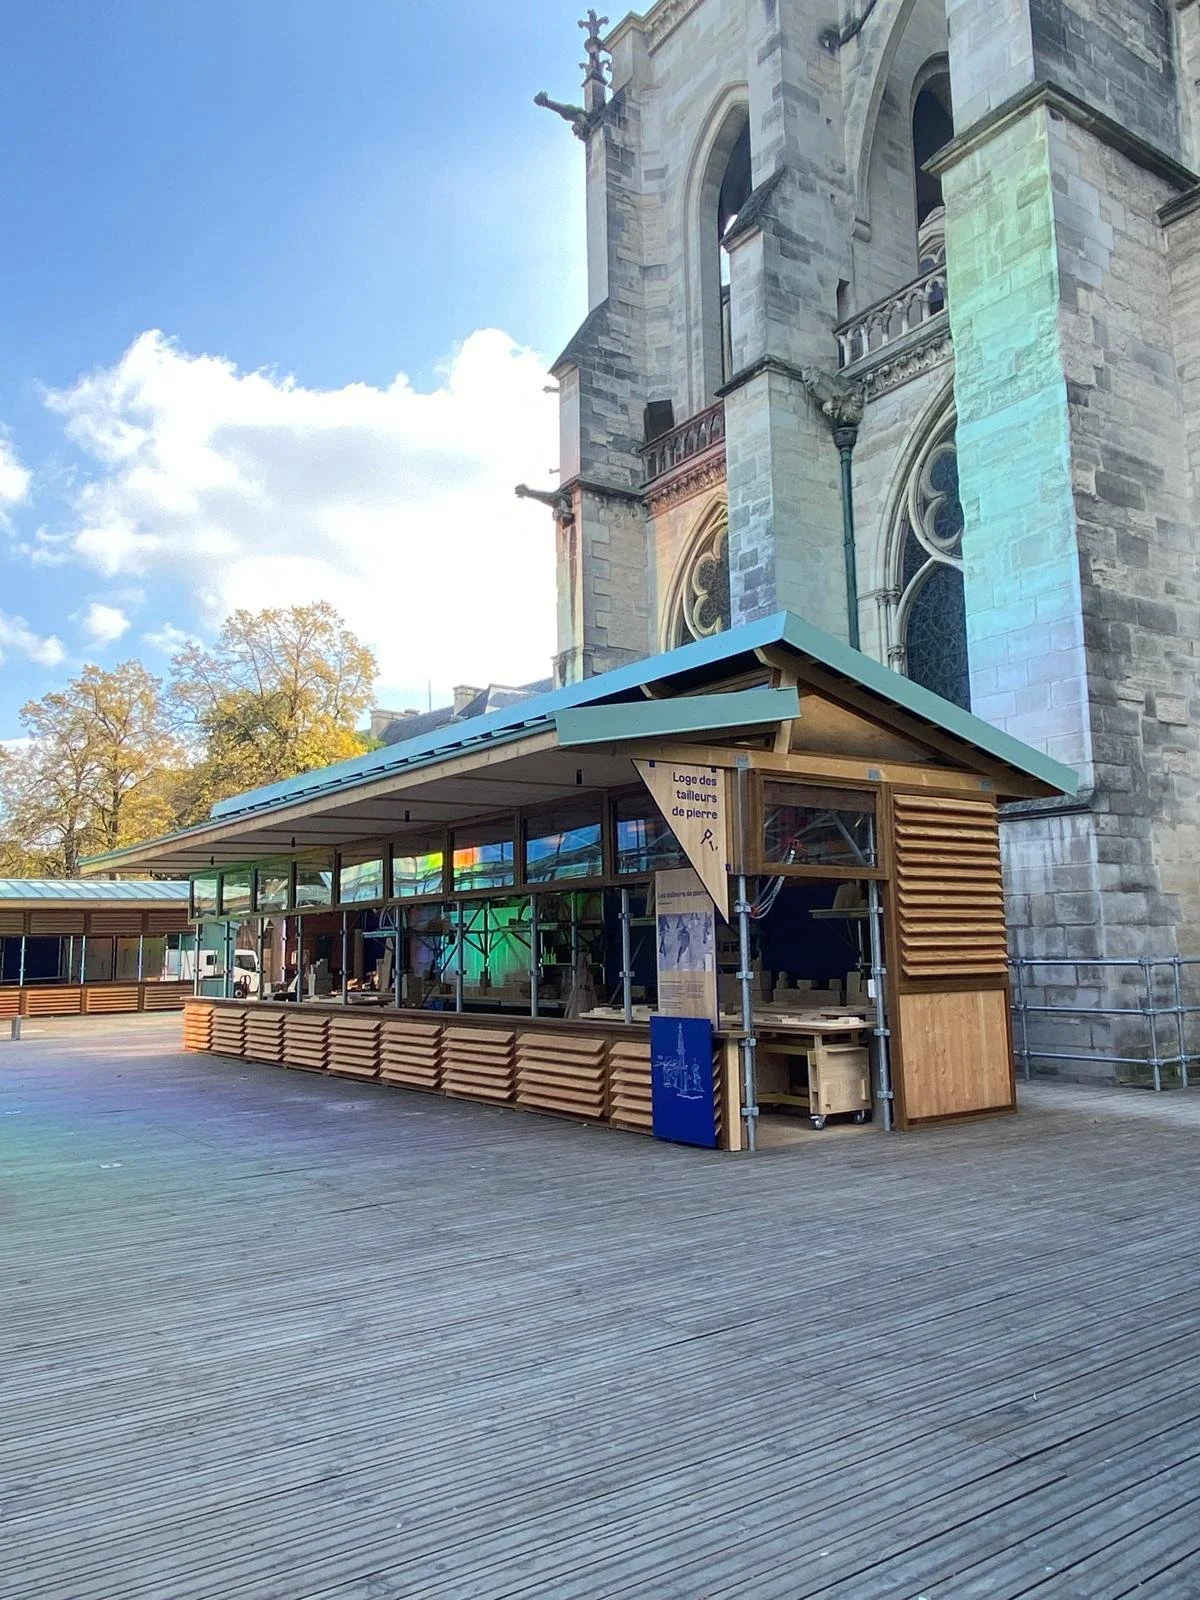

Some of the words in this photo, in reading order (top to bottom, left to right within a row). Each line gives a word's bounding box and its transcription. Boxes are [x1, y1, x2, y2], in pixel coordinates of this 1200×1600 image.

[673, 772, 697, 785] Loge
[699, 775, 717, 786] des
[676, 790, 718, 803] tailleurs
[672, 806, 685, 817] de
[686, 809, 718, 820] pierre
